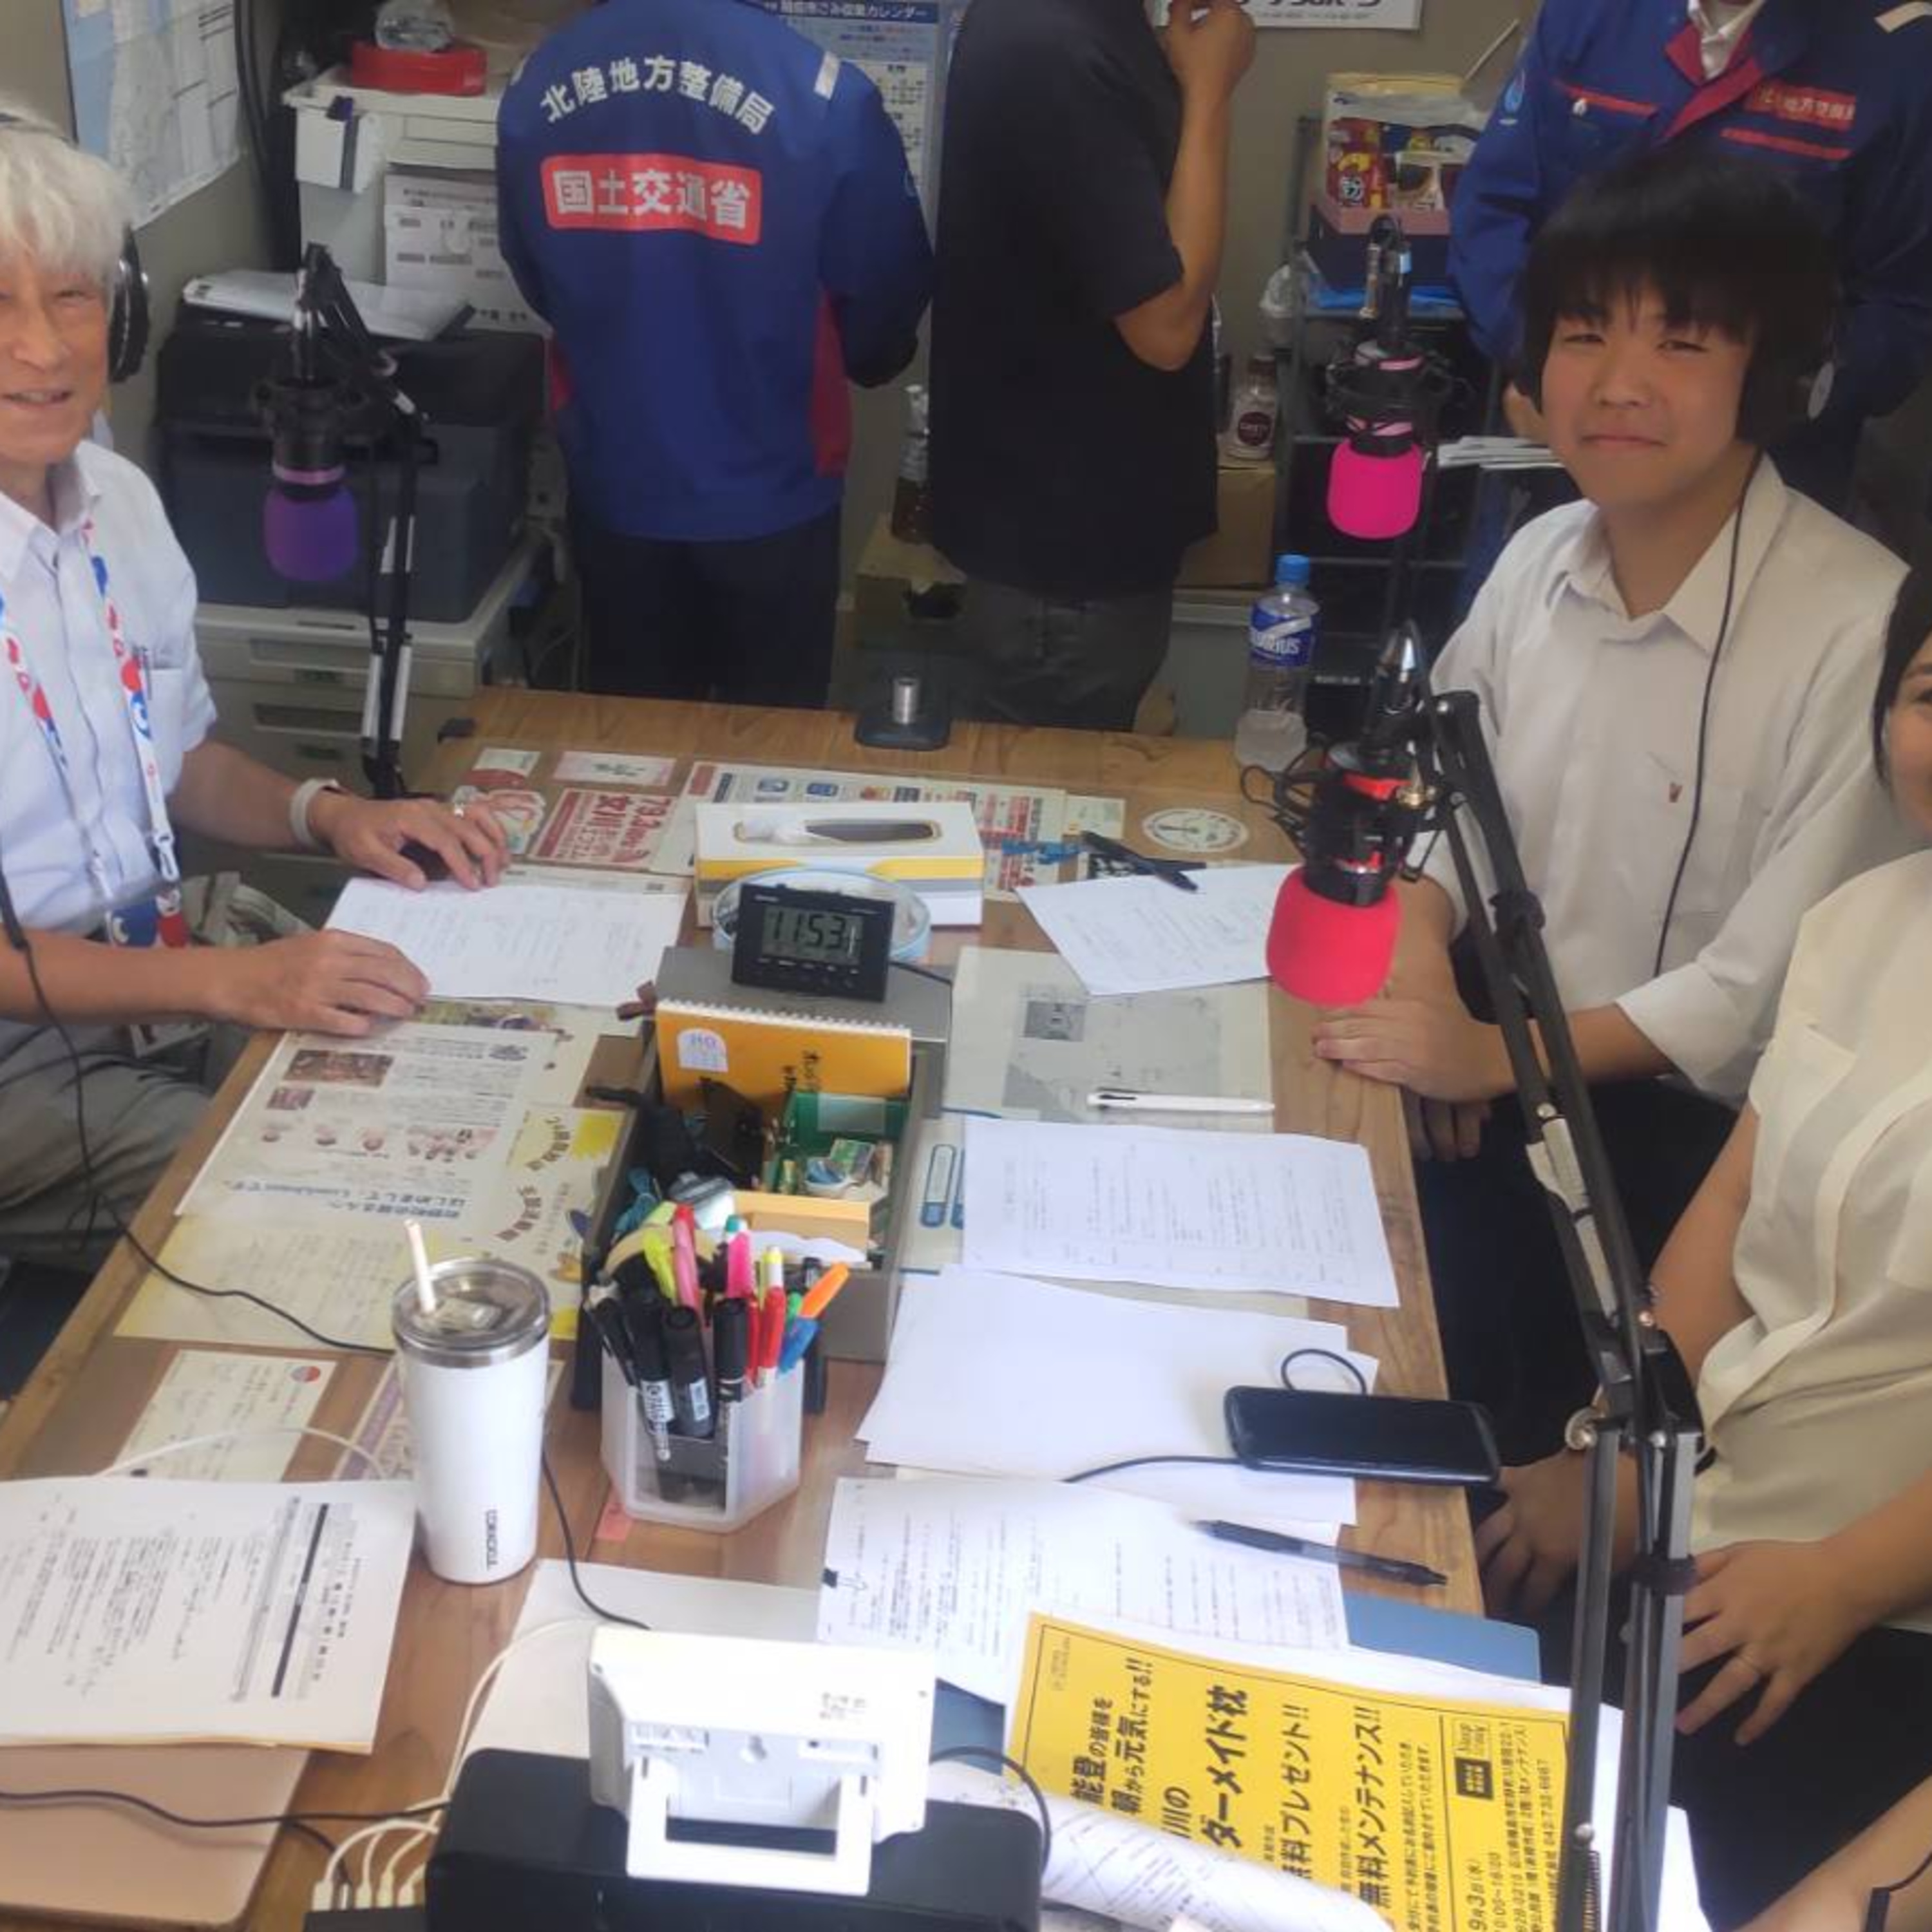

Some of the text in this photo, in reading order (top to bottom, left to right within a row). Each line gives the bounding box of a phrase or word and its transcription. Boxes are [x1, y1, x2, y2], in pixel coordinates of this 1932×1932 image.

[540, 54, 775, 134] 北陸地方整備局
[552, 168, 751, 229] 国土交通省
[1070, 1696, 1113, 1806] 能登の皆様を
[1162, 1786, 1192, 1839] 川の
[1354, 1705, 1392, 1909] 無料メンテナンス!!
